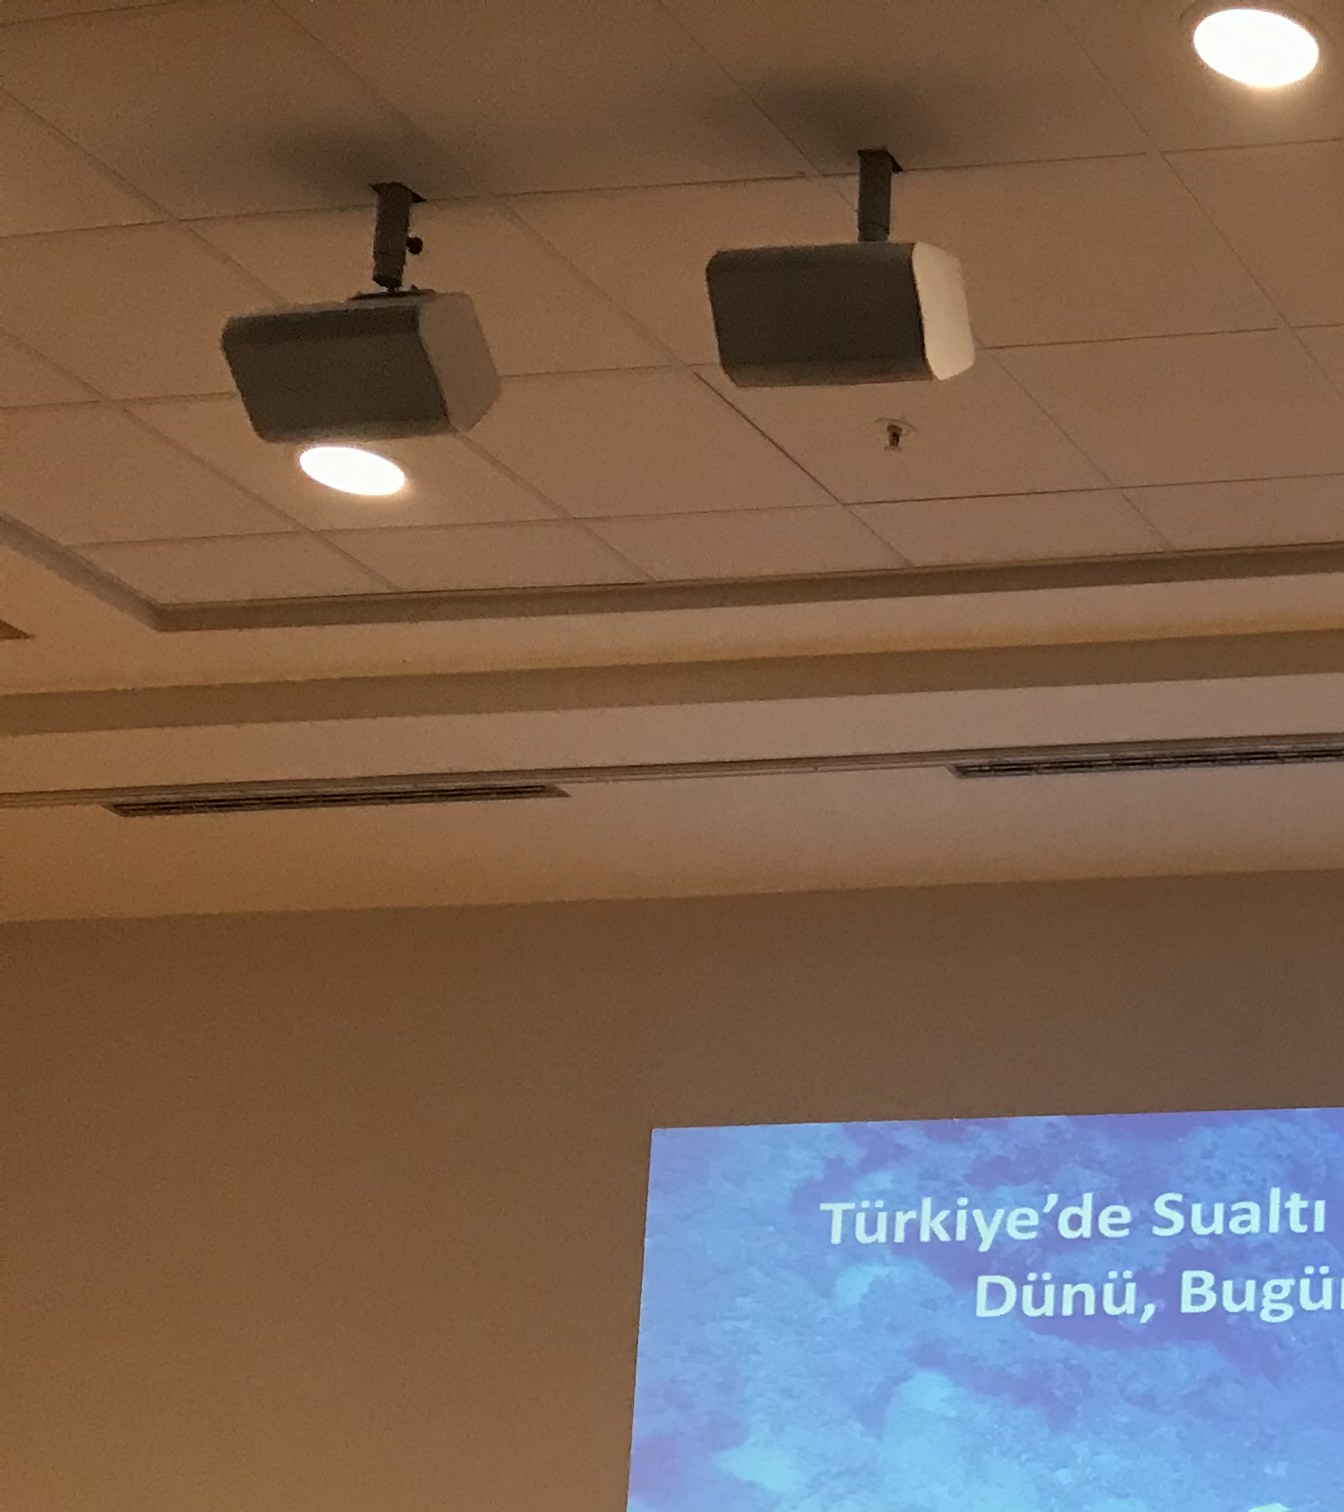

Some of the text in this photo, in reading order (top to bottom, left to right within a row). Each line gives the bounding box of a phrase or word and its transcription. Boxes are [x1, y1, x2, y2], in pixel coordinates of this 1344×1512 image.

[820, 1192, 1131, 1252] Türkiye’de
[1152, 1186, 1325, 1236] Sualtı
[975, 1270, 1156, 1324] Dünü,
